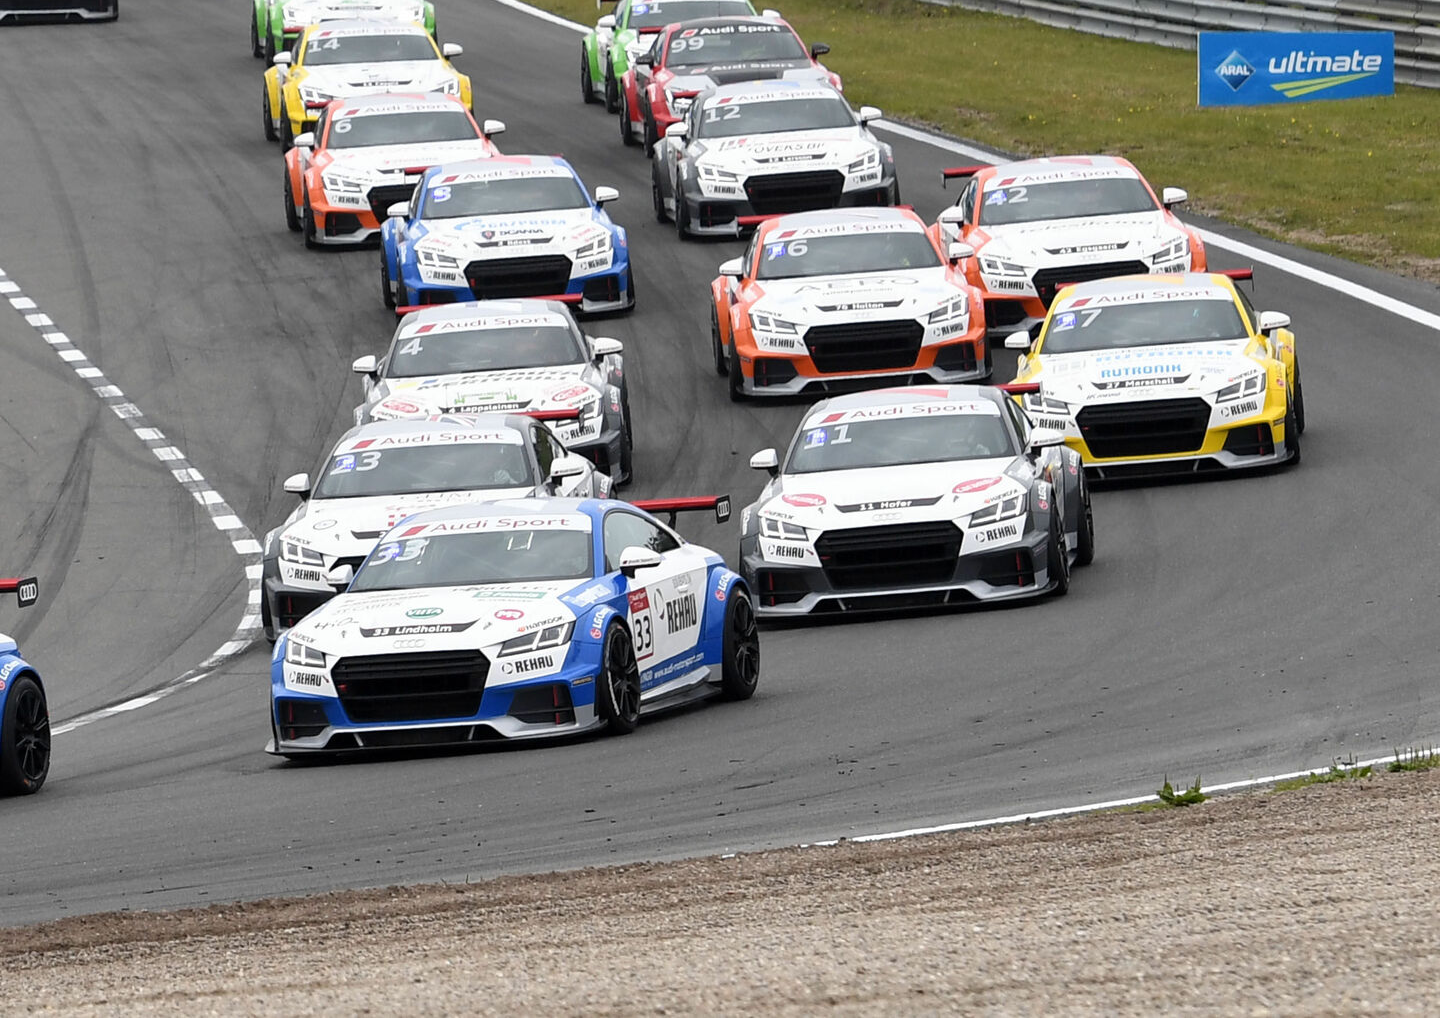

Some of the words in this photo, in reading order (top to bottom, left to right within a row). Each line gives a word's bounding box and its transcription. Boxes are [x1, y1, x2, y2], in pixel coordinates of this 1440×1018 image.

[700, 25, 734, 35] Audi
[740, 24, 781, 33] Sport
[308, 38, 341, 53] 14
[671, 37, 705, 53] 99
[1220, 66, 1250, 76] ARAL
[1268, 49, 1382, 74] ultimate
[738, 92, 774, 101] Audi
[365, 104, 400, 113] Audi
[406, 103, 449, 113] Sport
[705, 105, 741, 124] 12
[335, 119, 352, 133] 6
[463, 170, 503, 180] Audi
[509, 167, 558, 178] Sport
[1022, 170, 1065, 182] Audi
[1070, 168, 1119, 179] Sport
[985, 187, 1029, 206] 42
[802, 224, 846, 235] Audi
[852, 221, 905, 233] Sport
[432, 271, 457, 281] REHAU
[997, 280, 1024, 290] REHAU
[1097, 292, 1145, 303] Audi
[1152, 289, 1212, 300] Sport
[442, 319, 486, 330] Audi
[493, 316, 551, 327] Sport
[1053, 309, 1102, 333] 27
[941, 323, 964, 335] REHAU
[399, 338, 424, 355] 4
[769, 337, 795, 349] REHAU
[1101, 364, 1182, 378] RUTRONIK
[850, 406, 904, 418] Audi
[912, 403, 980, 414] Sport
[1230, 401, 1258, 416] REHAU
[1039, 418, 1066, 430] REHAU
[381, 433, 432, 445] Audi
[440, 431, 503, 442] Sport
[570, 425, 596, 439] REHAU
[803, 424, 853, 450] 11
[330, 451, 382, 475] 23
[881, 499, 912, 509] Hofer
[431, 518, 484, 532] Audi
[496, 516, 570, 528] Sport
[986, 525, 1017, 542] REHAU
[775, 545, 804, 559] REHAU
[294, 569, 321, 581] REHAU
[666, 594, 698, 635] REHAU
[373, 627, 391, 636] 33
[395, 623, 453, 635] Lindholm
[635, 615, 652, 652] 33
[516, 656, 554, 673] REHAU
[296, 673, 322, 687] REHAU
